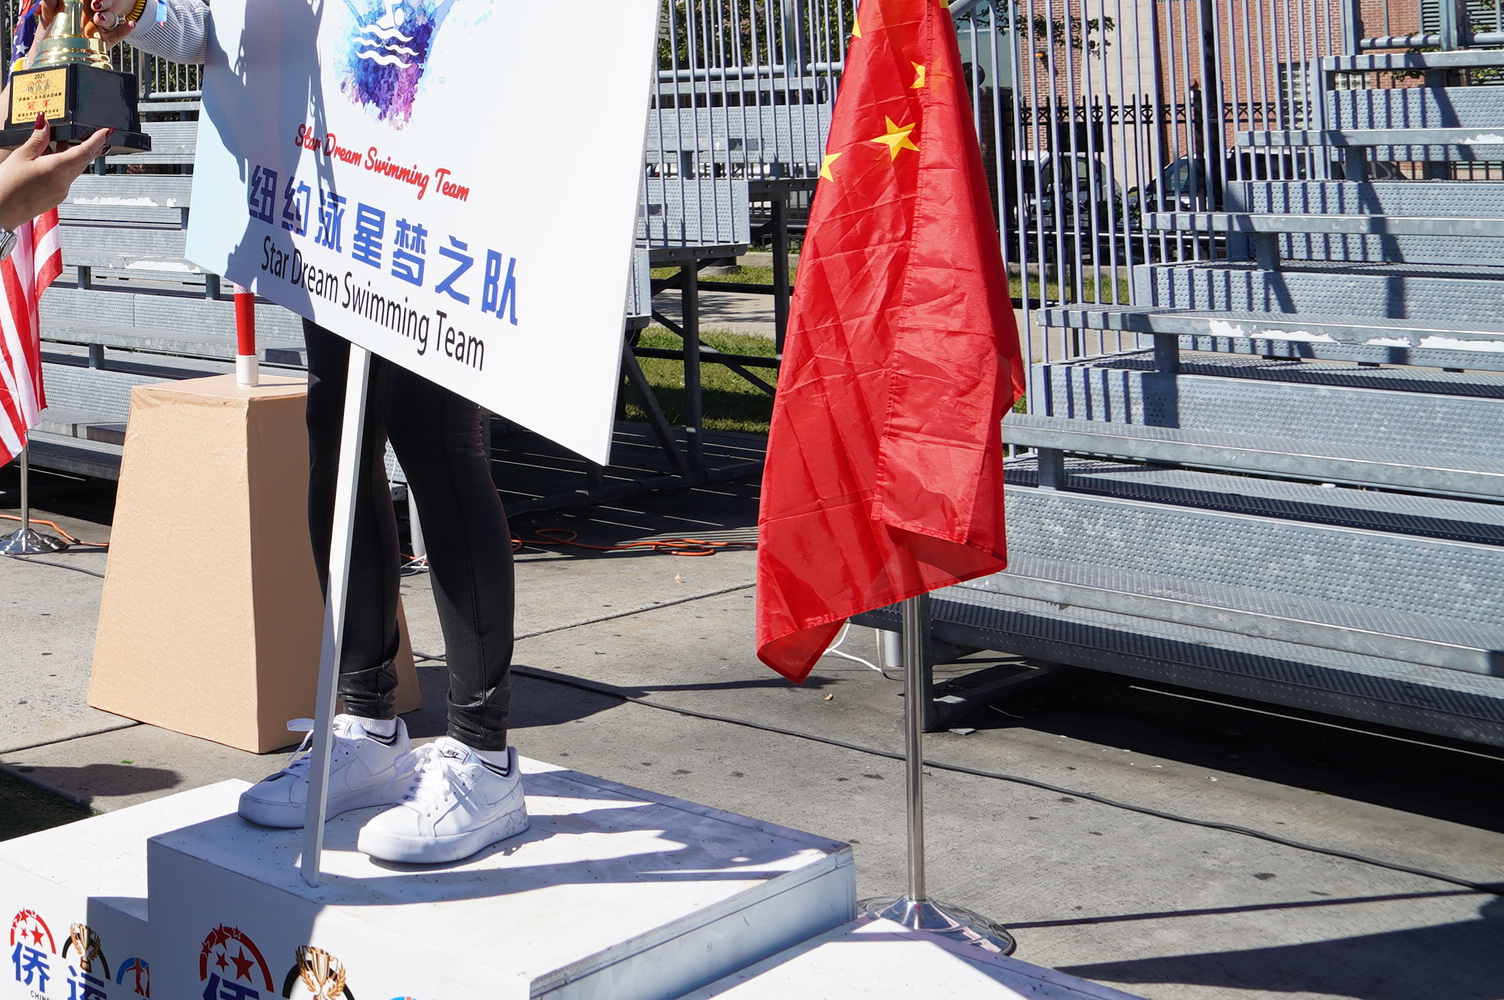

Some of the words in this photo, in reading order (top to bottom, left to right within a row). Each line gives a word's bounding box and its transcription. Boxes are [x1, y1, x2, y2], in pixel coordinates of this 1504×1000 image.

[295, 124, 321, 151] Star
[324, 133, 362, 166] Dream
[365, 147, 430, 200] Swimming
[435, 168, 470, 202] Team
[248, 165, 518, 326] 纽约泳星梦之队
[261, 235, 289, 279] Star
[291, 248, 339, 304] Dream
[342, 271, 430, 355] Swimming
[435, 310, 485, 371] Team
